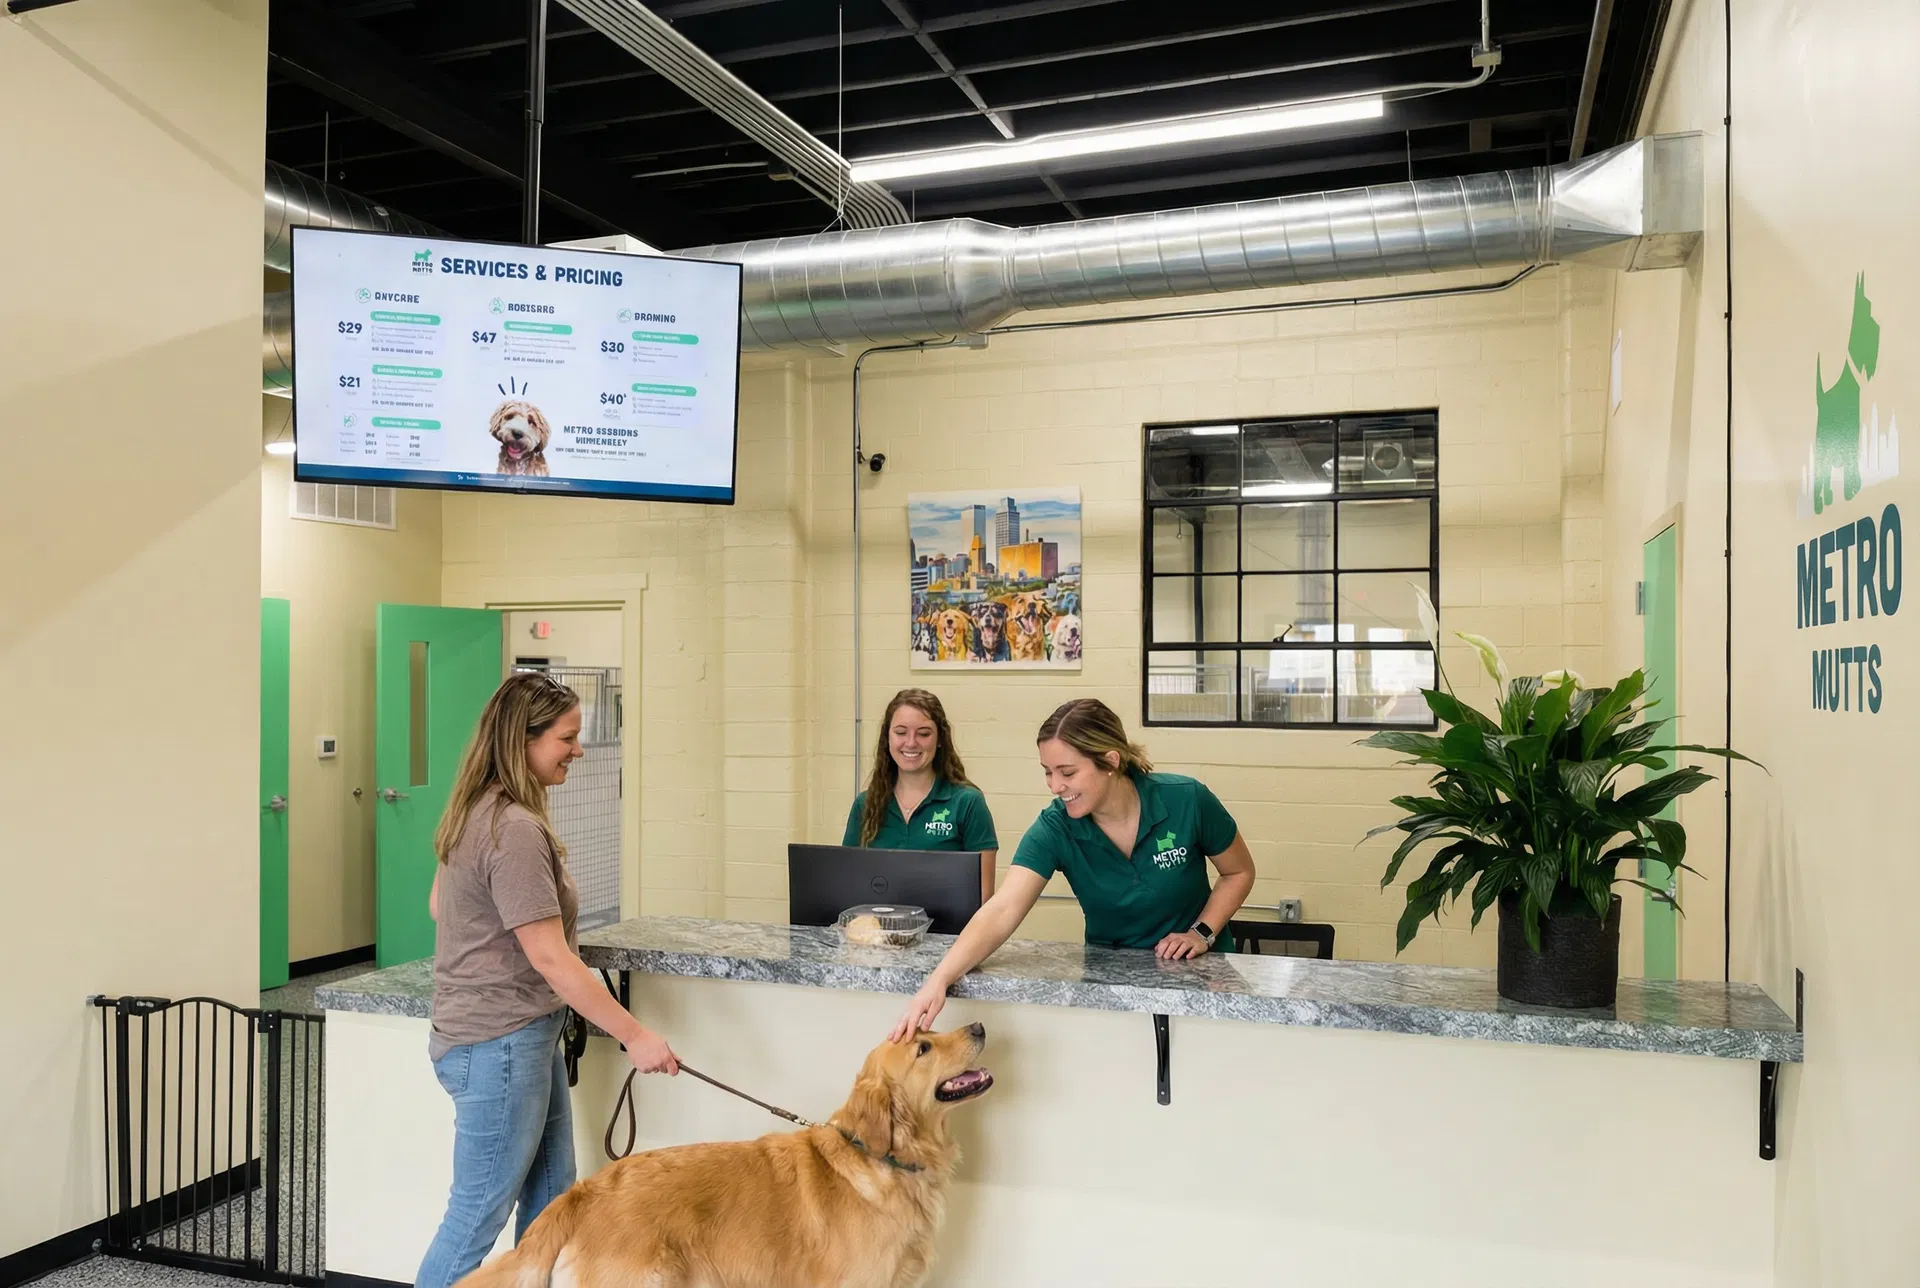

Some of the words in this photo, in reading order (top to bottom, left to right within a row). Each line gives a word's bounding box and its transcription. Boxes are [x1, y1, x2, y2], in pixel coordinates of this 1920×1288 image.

[440, 257, 529, 280] SERVICES
[535, 264, 547, 281] &
[555, 266, 623, 287] PRICING
[338, 320, 363, 334] $29
[472, 330, 497, 346] $47
[601, 339, 625, 355] $30
[339, 375, 361, 388] $21
[563, 425, 593, 435] METRO
[1797, 503, 1903, 629] METRO
[1812, 643, 1882, 714] MUTTS
[1152, 846, 1187, 865] METRO
